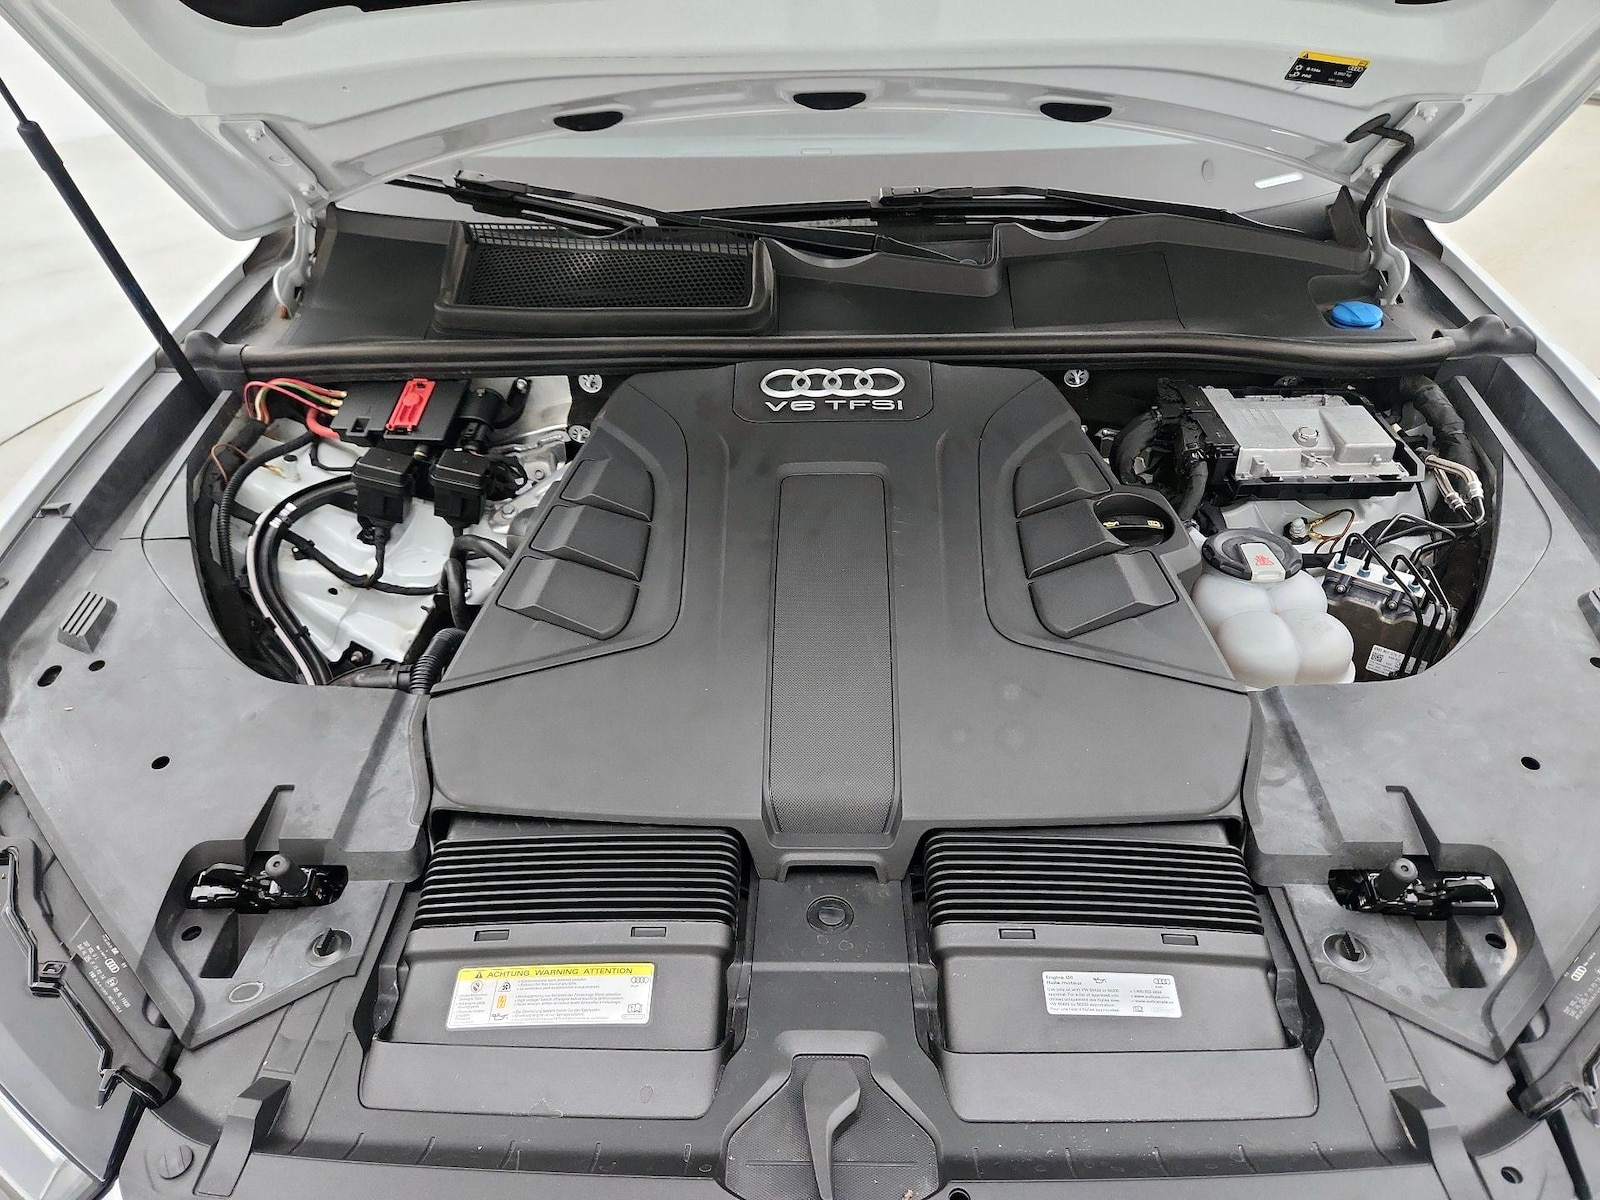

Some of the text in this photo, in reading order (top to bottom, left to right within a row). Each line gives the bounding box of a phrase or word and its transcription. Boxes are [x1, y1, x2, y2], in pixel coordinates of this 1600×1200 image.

[764, 400, 904, 412] V6 TFSI
[486, 967, 633, 978] ACHTUNG WARNING ATTENTION
